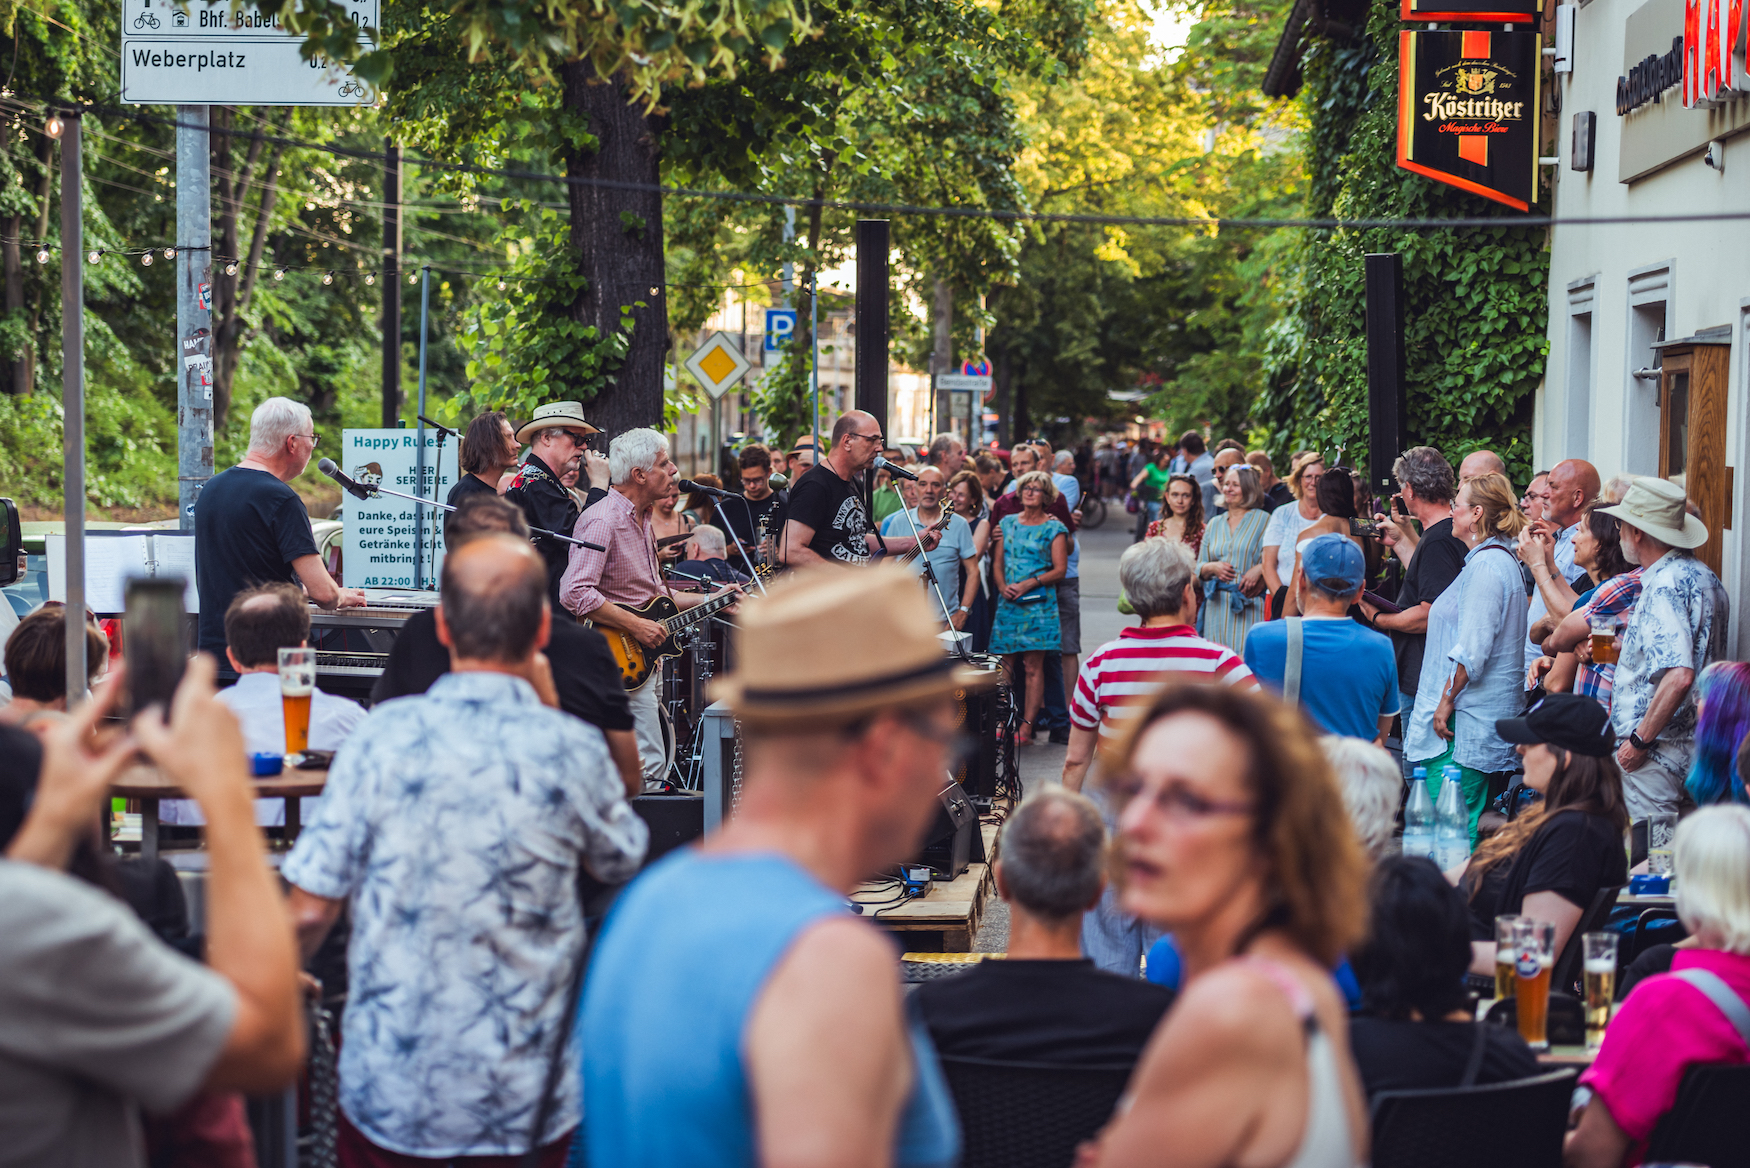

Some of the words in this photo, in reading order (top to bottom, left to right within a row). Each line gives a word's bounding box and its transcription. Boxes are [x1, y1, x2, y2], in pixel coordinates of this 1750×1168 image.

[200, 10, 227, 28] Bhf.
[236, 10, 281, 28] Babel
[133, 49, 246, 72] Weberplatz
[1422, 92, 1524, 122] Köstritzer
[1438, 121, 1482, 135] Magische
[1482, 122, 1509, 133] Biere
[771, 315, 794, 346] P
[354, 436, 399, 450] Happy
[409, 466, 435, 475] HER
[396, 476, 448, 485] SERIERE
[413, 486, 431, 495] IH
[358, 511, 397, 522] Danke,
[834, 506, 847, 528] SONS
[359, 526, 384, 535] eure
[387, 525, 430, 537] Speisn
[359, 539, 410, 549] Getränke
[427, 554, 431, 563] !
[364, 577, 379, 586] AB
[381, 577, 411, 586] 22:00
[414, 577, 436, 586] HR
